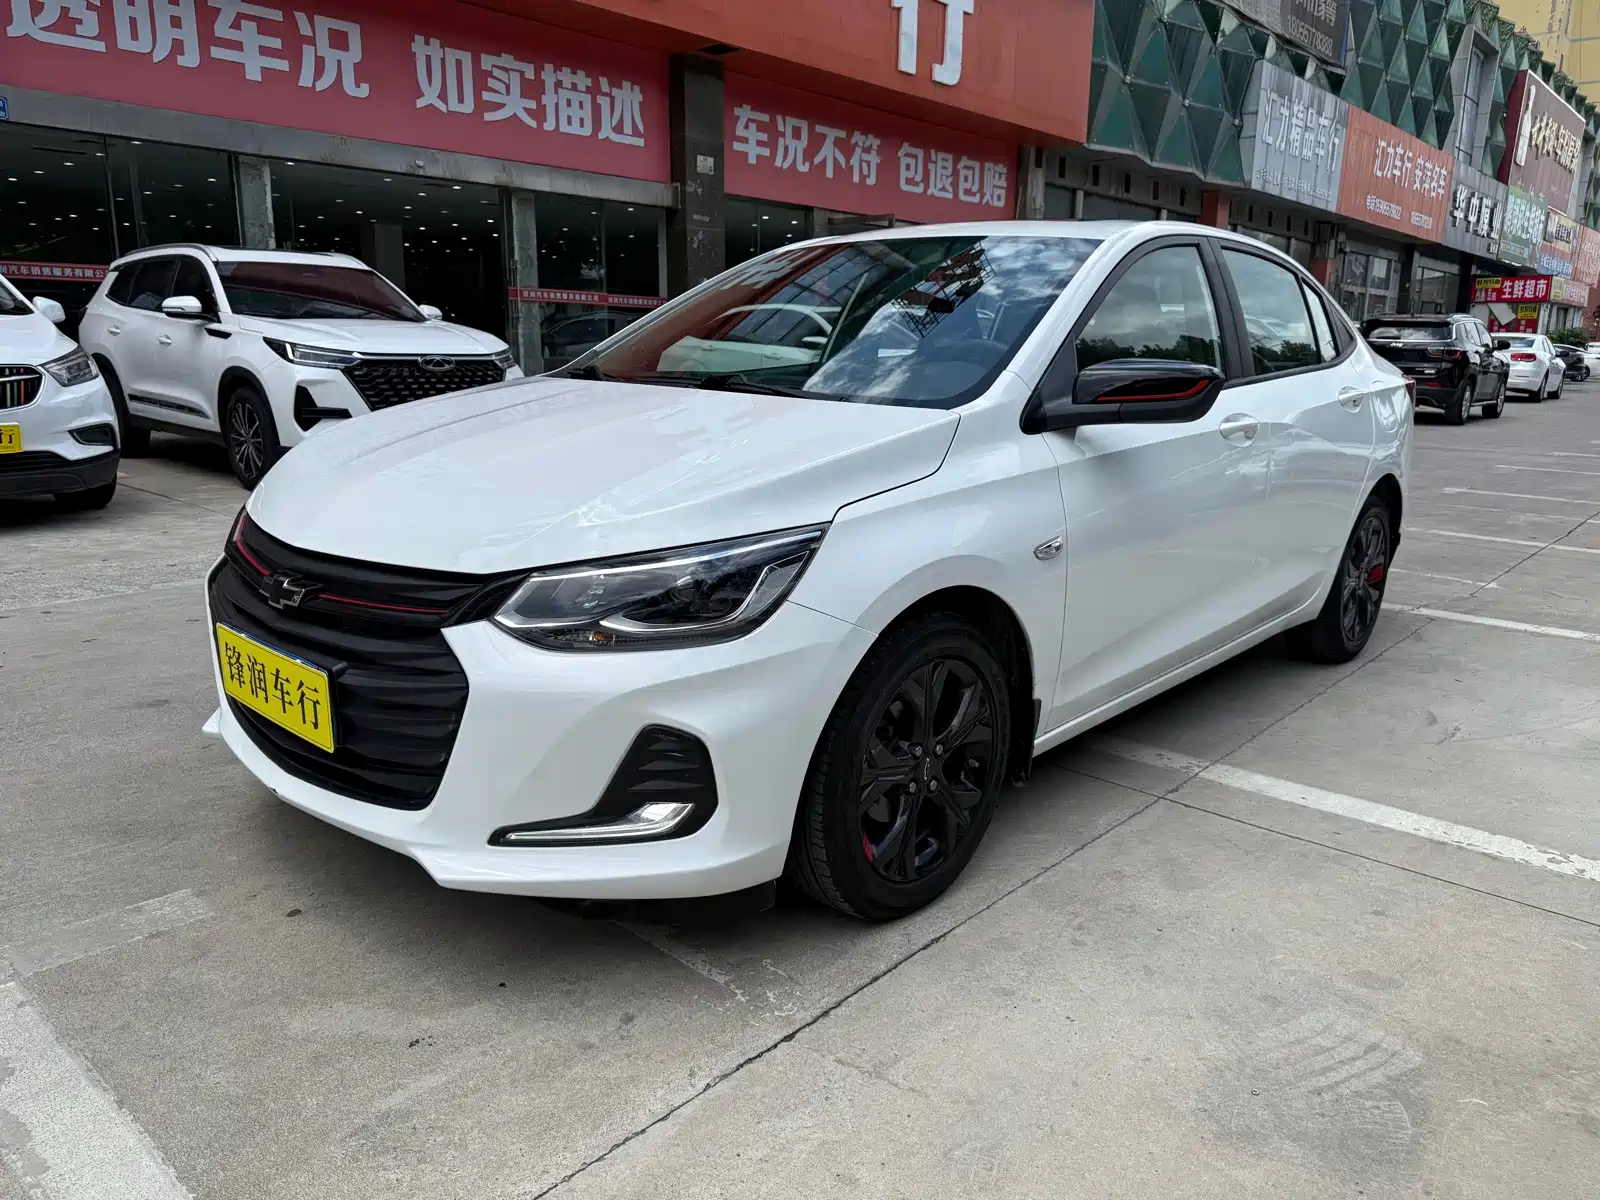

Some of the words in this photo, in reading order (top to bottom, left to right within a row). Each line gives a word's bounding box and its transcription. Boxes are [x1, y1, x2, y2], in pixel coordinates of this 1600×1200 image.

[6, 0, 369, 98] 透明车况
[411, 34, 645, 147] 如实描述
[733, 104, 882, 186] 车况不符
[898, 142, 1007, 207] 包退包赔
[1262, 88, 1340, 172] 汇力精品车行
[1374, 138, 1412, 189] 汇力车行
[1502, 279, 1548, 299] 生鲜超市
[225, 641, 321, 730] 锋润车行
